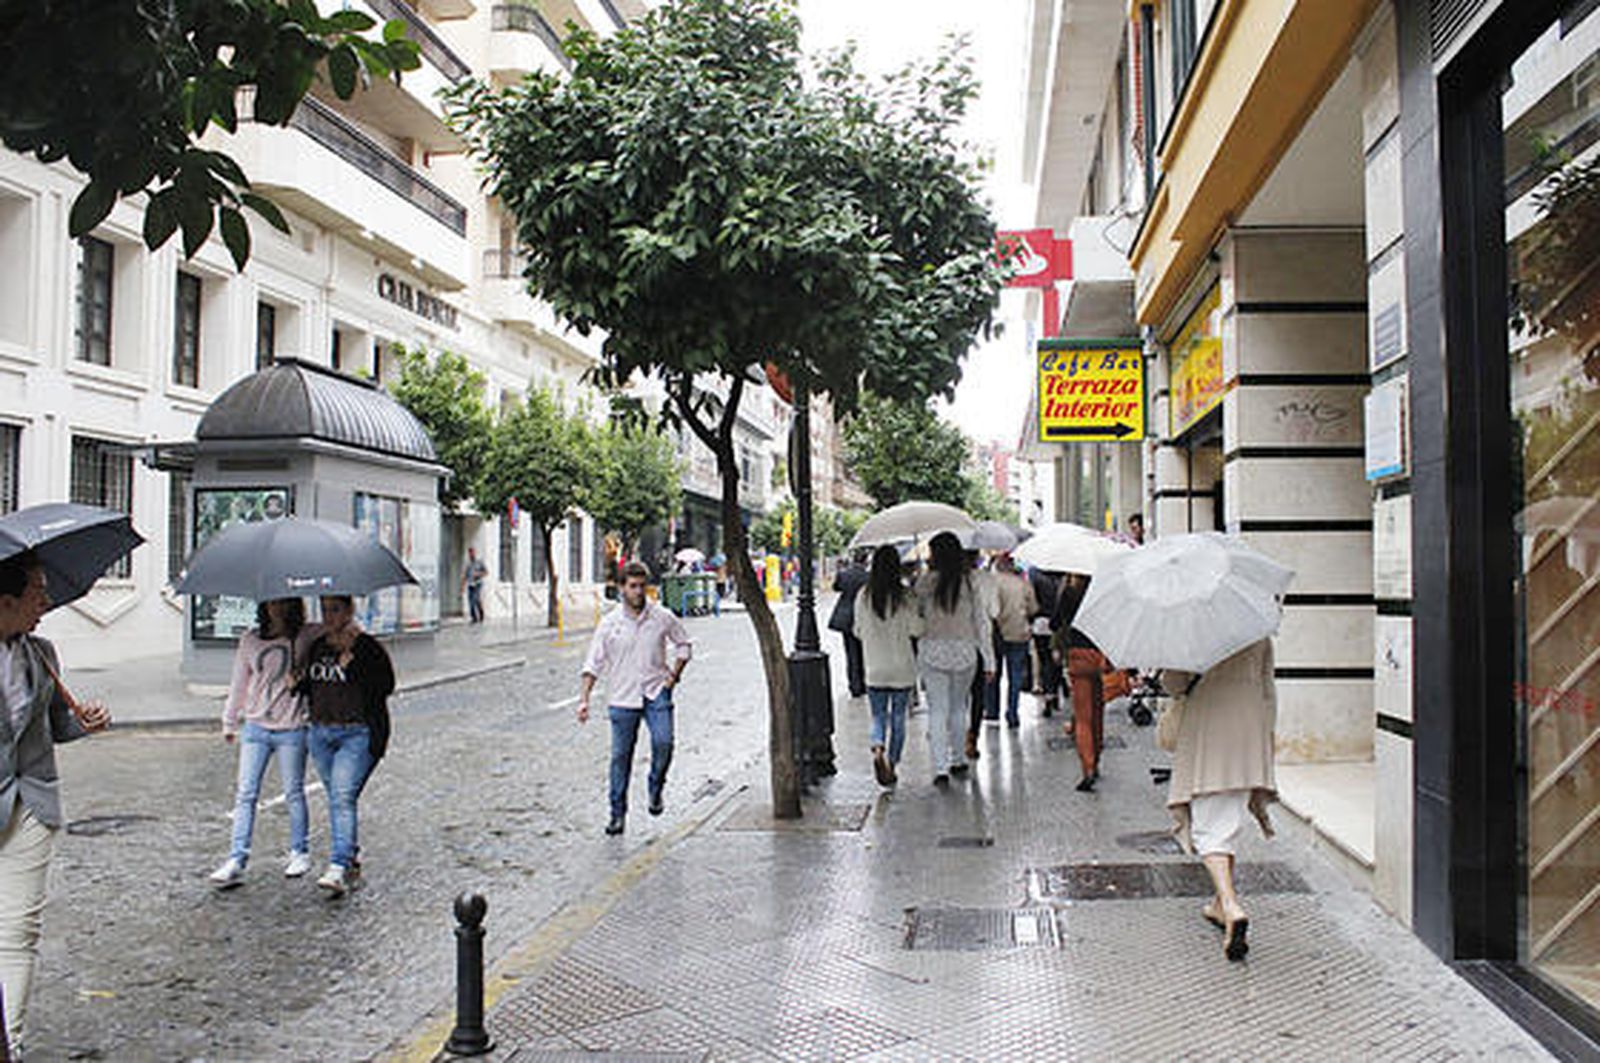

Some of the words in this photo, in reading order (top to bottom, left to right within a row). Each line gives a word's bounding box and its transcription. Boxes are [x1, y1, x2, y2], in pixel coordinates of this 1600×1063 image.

[1099, 352, 1138, 370] Bar
[1045, 374, 1138, 396] Terraza
[1045, 397, 1138, 418] Interior
